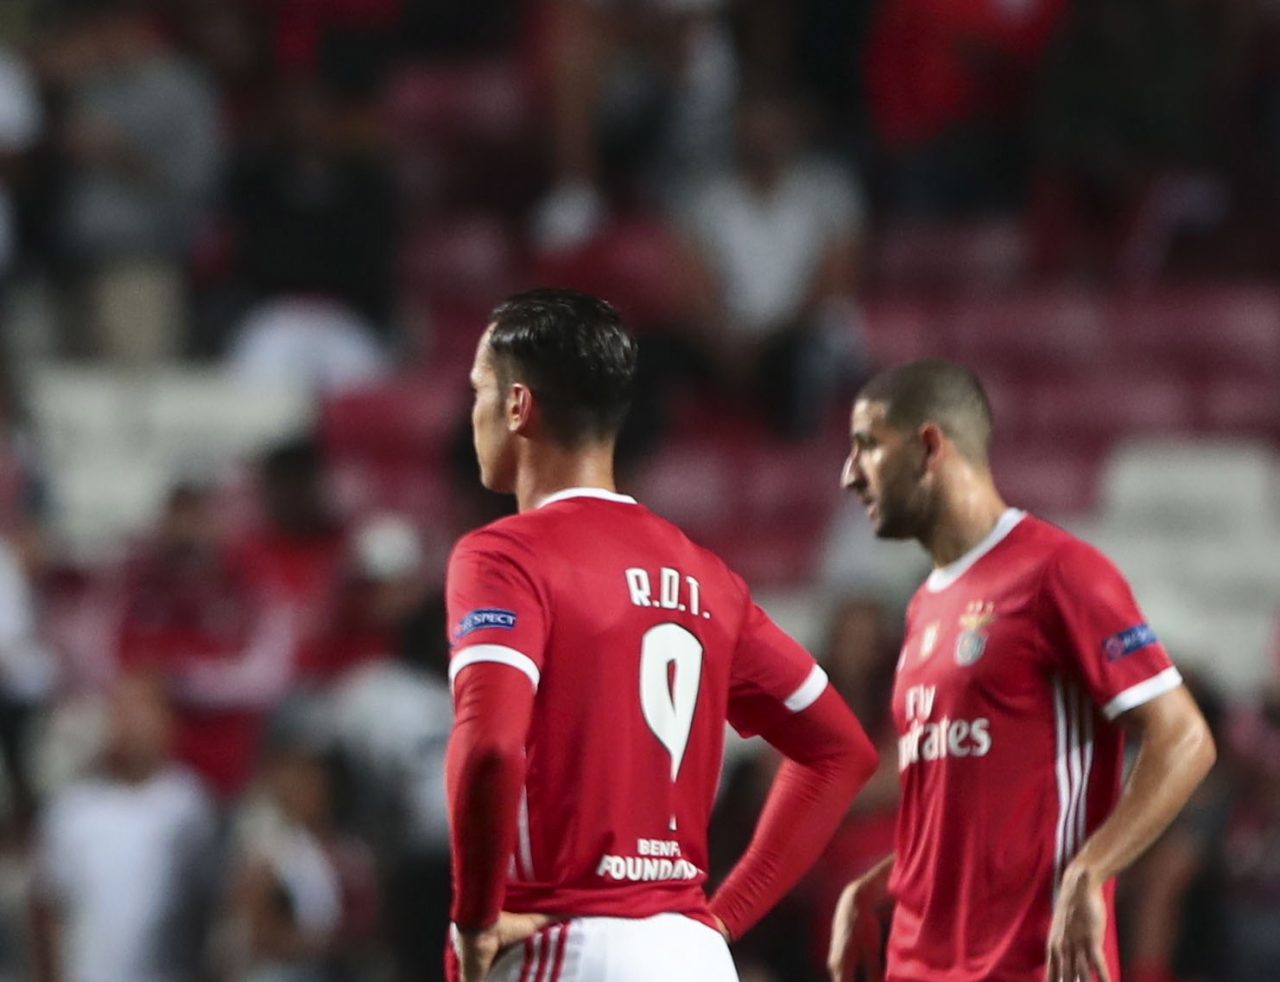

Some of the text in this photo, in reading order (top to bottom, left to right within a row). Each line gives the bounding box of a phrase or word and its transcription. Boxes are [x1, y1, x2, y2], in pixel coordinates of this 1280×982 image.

[625, 566, 711, 619] R.D.T.
[639, 622, 704, 830] 9
[637, 838, 682, 857] BENF
